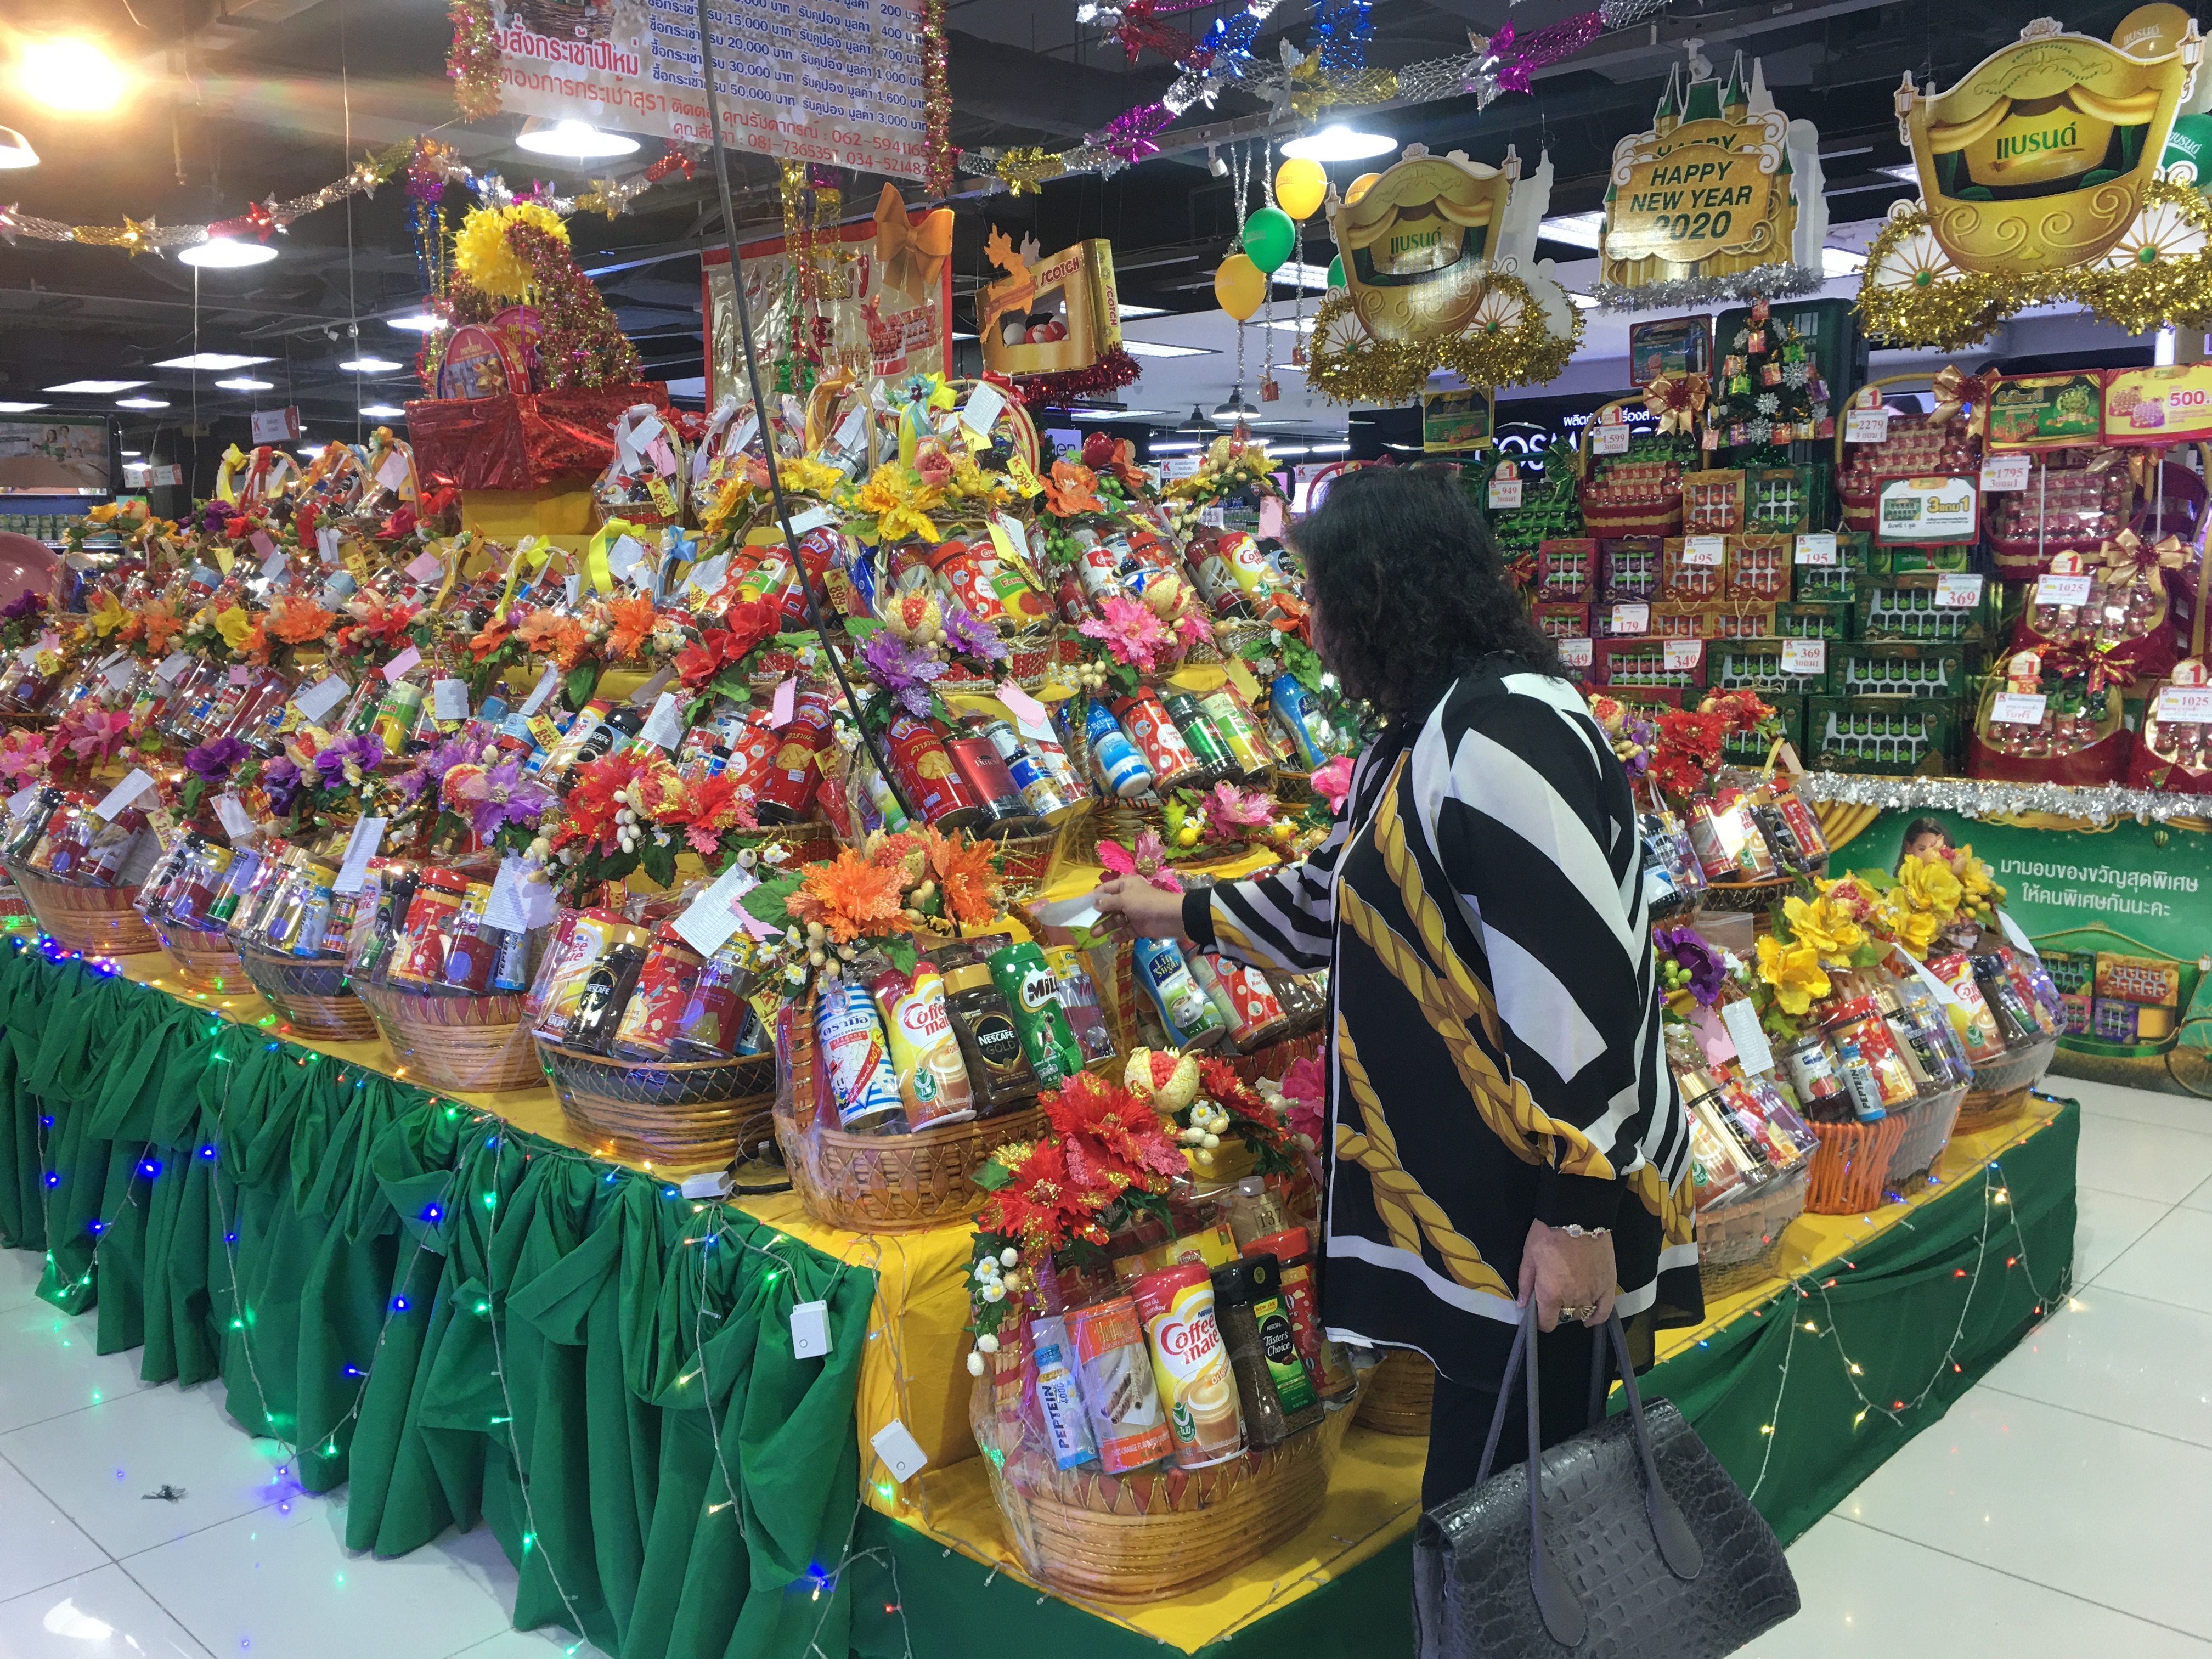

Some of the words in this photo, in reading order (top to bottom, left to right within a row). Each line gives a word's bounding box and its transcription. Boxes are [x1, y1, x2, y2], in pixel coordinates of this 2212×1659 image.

[771, 1, 791, 14] บาท
[798, 5, 840, 26] รับคูปอง
[844, 16, 870, 32] มูลค่า
[881, 26, 902, 40] 400
[881, 4, 901, 17] 200
[727, 14, 768, 32] 15,000
[772, 24, 792, 38] บาท
[799, 28, 842, 48] รับคูปอง
[845, 38, 871, 55] มูลค่า
[882, 47, 902, 62] 700
[727, 37, 769, 55] 20,000
[773, 48, 793, 60] บาท
[800, 51, 843, 71] รับคูปอง
[847, 60, 872, 78] มูลค่า
[877, 69, 906, 84] 1,000
[910, 76, 923, 87] บา
[729, 60, 770, 79] 30,000
[774, 71, 794, 84] บาท
[802, 74, 844, 94] รับคูปอง
[848, 83, 873, 100] มูลค่า
[878, 91, 907, 106] 1,600
[499, 53, 666, 116] ต้องการกระเช้าสุรา
[832, 129, 929, 158] 062-5941165
[730, 85, 771, 102] 50,000
[775, 94, 795, 107] บาท
[803, 97, 845, 117] รับคูปอง
[849, 105, 874, 122] มูลค่า
[878, 112, 907, 128] 3,000
[1997, 121, 2078, 160] แบรนด์
[1650, 161, 1734, 187] HAPPY
[1629, 190, 1685, 213] NEW
[1691, 185, 1753, 209] YEAR
[1652, 211, 1733, 240] 2020
[1390, 227, 1442, 255] แบรนด์
[1040, 256, 1080, 287] SCOTCH
[1105, 284, 1118, 326] SCOTCH
[290, 416, 296, 430] 8
[1859, 420, 1884, 430] 2279
[1996, 469, 2024, 478] 1795
[1502, 486, 1517, 494] 949
[1927, 495, 1971, 513] 3แถม1
[1945, 591, 1976, 606] 369
[2058, 584, 2084, 592] 1025
[1801, 648, 1820, 658] 369
[2182, 696, 2209, 706] 1025
[2000, 858, 2198, 893] มามอบของขวัญสุดพิเศษ
[2022, 882, 2171, 917] ให้คนพิเศษกันนะคะ
[742, 1011, 758, 1042] PEPT
[823, 1015, 869, 1036] ตรามือ
[869, 1045, 881, 1065] 20%
[986, 1040, 1017, 1056] GOLD
[1852, 1069, 1871, 1109] PEPTEIN
[1258, 1207, 1283, 1229] 137
[1255, 1304, 1266, 1312] NEW
[1160, 1313, 1215, 1356] Coffee
[1181, 1329, 1220, 1365] mate
[1263, 1330, 1289, 1347] Taster's
[1267, 1342, 1292, 1357] Choice
[1056, 1382, 1068, 1404] 4000
[1042, 1385, 1070, 1449] PEPTEIN
